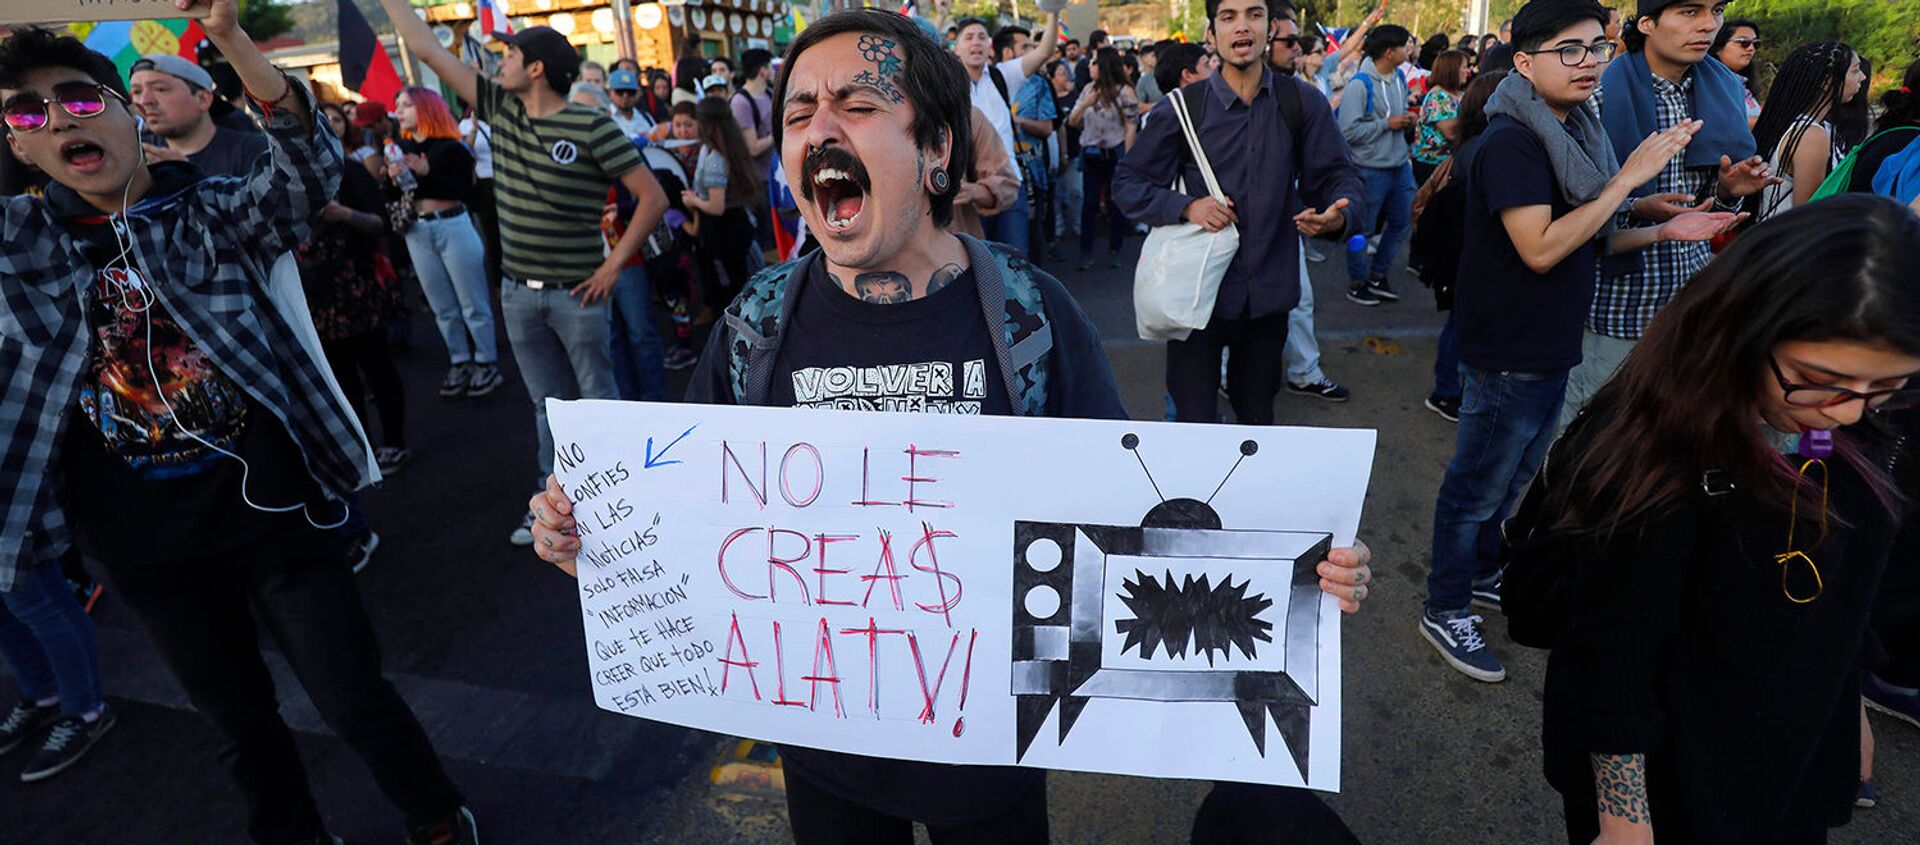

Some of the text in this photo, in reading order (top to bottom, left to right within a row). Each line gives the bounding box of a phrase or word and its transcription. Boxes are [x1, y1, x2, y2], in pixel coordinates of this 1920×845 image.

[792, 359, 987, 402] VOLVER A
[556, 442, 585, 473] NO
[720, 440, 961, 513] NO LE
[594, 498, 634, 529] LAS
[616, 560, 666, 588] FALSA
[594, 639, 626, 661] QUE
[655, 616, 696, 640] HACE
[596, 662, 638, 686] CREER
[640, 652, 671, 673] QUE
[612, 684, 657, 712] ESTA
